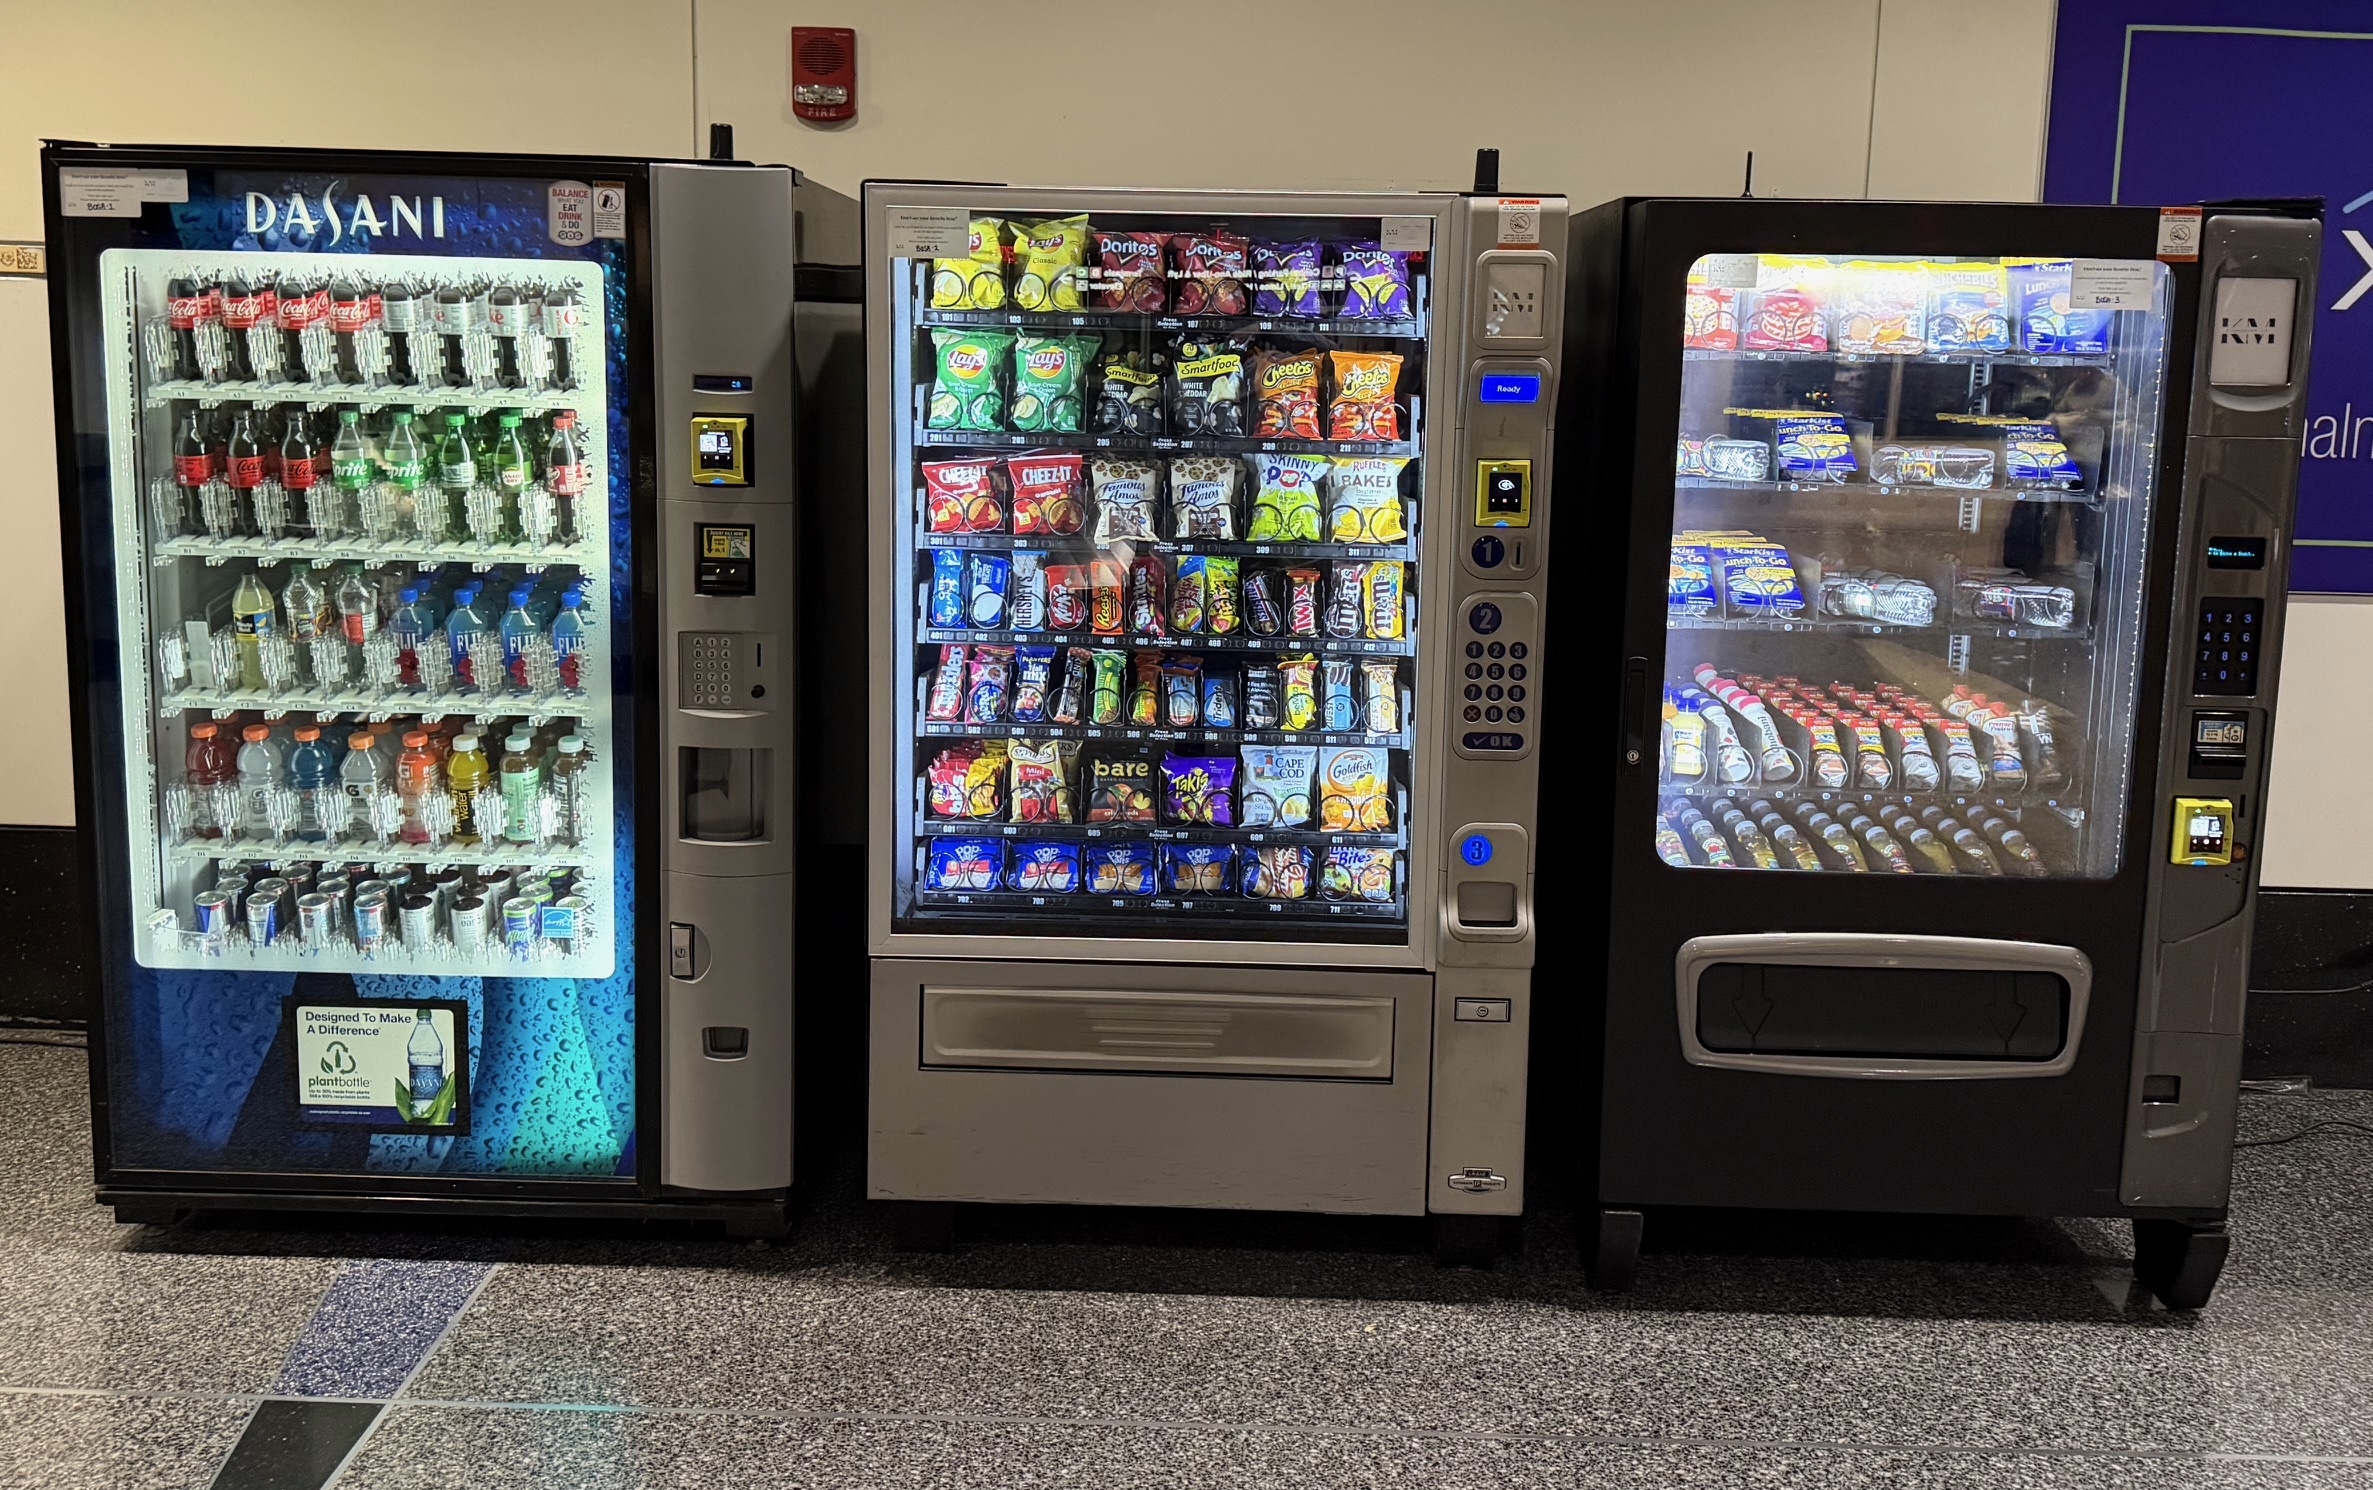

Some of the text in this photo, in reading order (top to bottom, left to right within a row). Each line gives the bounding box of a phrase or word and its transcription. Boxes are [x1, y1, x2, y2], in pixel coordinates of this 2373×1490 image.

[808, 108, 836, 117] FIRE
[552, 188, 589, 199] BALANCE
[563, 203, 578, 211] EAT
[246, 180, 444, 246] DASANI
[558, 212, 583, 221] DRINK
[561, 221, 580, 229] & DO
[1101, 238, 1158, 256] Doritos
[1185, 244, 1242, 260] Doritos
[1033, 257, 1058, 265] Classic
[1343, 250, 1396, 270] Doritos
[942, 314, 953, 322] 101
[1009, 315, 1021, 323] 103
[1072, 317, 1084, 325] 105
[1187, 320, 1199, 328] 107
[1259, 322, 1272, 330] 109
[1027, 351, 1064, 368] Lay's
[1181, 359, 1238, 376] Smartfood
[1262, 361, 1314, 387] Cheetos
[1103, 383, 1125, 391] WHITE
[1182, 382, 1204, 390] WHITE
[1342, 371, 1390, 397] Cheetos
[1497, 384, 1521, 394] Ready
[930, 434, 942, 442] 201
[1012, 436, 1025, 444] 203
[1097, 438, 1109, 447] 205
[1181, 441, 1193, 449] 207
[1262, 442, 1275, 450] 209
[1269, 454, 1319, 472] SKINNY
[1353, 460, 1387, 472] RUFFLES
[1022, 465, 1072, 485] CHEEZ-IT
[1266, 466, 1311, 488] POP
[1100, 481, 1145, 495] Famous
[1177, 480, 1225, 499] Famous
[1108, 489, 1140, 501] Amos
[1188, 488, 1219, 503] Amos
[930, 537, 942, 545] 301
[1181, 544, 1193, 552] 307
[1348, 548, 1360, 556] 311
[1483, 541, 1492, 562] 1
[1732, 547, 1775, 555] StarKist
[1016, 575, 1033, 626] HERSHEY'S
[1174, 576, 1194, 620] Swedish
[1184, 585, 1200, 609] Fish
[1293, 585, 1313, 632] TWIX
[1479, 608, 1492, 629] 2
[2206, 613, 2212, 622] 1
[2226, 613, 2232, 623] 2
[2244, 614, 2251, 623] 3
[393, 632, 417, 650] FIJI
[931, 632, 942, 640] 401
[1014, 634, 1027, 642] 403
[1054, 635, 1067, 643] 404
[2204, 632, 2210, 641] 4
[2223, 632, 2230, 642] 5
[2243, 633, 2249, 642] 6
[558, 637, 583, 654] FIJI
[1181, 638, 1192, 646] 407
[1289, 641, 1301, 649] 410
[1326, 642, 1337, 650] 411
[1364, 642, 1375, 650] 412
[1471, 644, 1477, 655] 1
[1493, 644, 1500, 656] 2
[1515, 645, 1522, 657] 3
[1022, 656, 1051, 664] PLANTERS
[2203, 651, 2209, 660] 7
[2222, 651, 2228, 661] 8
[2241, 651, 2248, 661] 9
[1072, 657, 1082, 676] KIND
[1469, 666, 1476, 677] 4
[1023, 670, 1046, 682] mix
[1491, 666, 1499, 678] 5
[1513, 666, 1521, 678] 6
[2220, 670, 2226, 680] 0
[1470, 687, 1476, 698] 7
[1491, 688, 1498, 699] 8
[1513, 688, 1520, 699] 9
[1213, 684, 1223, 721] Trident
[1490, 709, 1497, 720] 0
[927, 725, 940, 733] 501
[1088, 729, 1100, 737] 505
[1175, 731, 1187, 739] 507
[1285, 734, 1297, 742] 510
[1365, 736, 1376, 744] 512
[1490, 736, 1512, 746] OK
[1276, 757, 1304, 768] CAPE
[1025, 766, 1045, 776] Mini
[1094, 760, 1149, 777] bare
[1279, 768, 1304, 779] COD
[1333, 760, 1372, 778] Goldfish
[1173, 771, 1209, 798] Takis
[1176, 831, 1188, 839] 607
[1250, 833, 1263, 841] 609
[1332, 835, 1343, 843] 611
[1471, 841, 1483, 859] 3
[1338, 852, 1373, 866] Bites
[1330, 905, 1340, 913] 711
[305, 1011, 411, 1024] Designed To Make
[307, 1025, 380, 1036] A Difference
[308, 1075, 370, 1088] plantbottle
[411, 1078, 443, 1087] DASANI
